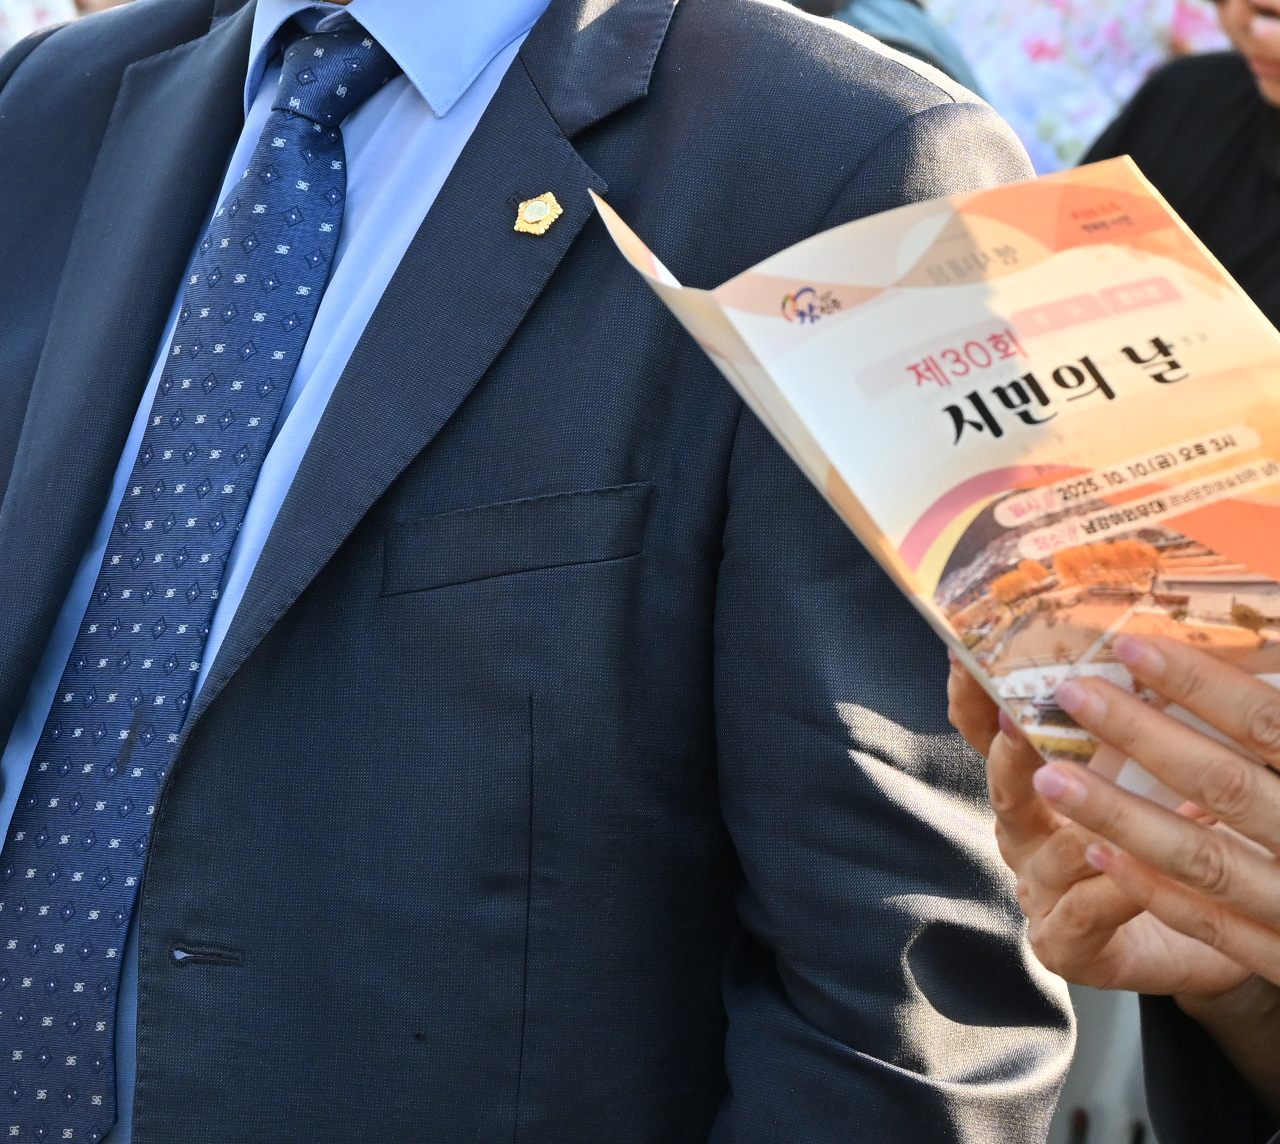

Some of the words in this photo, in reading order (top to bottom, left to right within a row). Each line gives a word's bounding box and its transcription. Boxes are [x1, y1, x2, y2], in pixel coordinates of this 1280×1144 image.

[906, 328, 1029, 387] 제30회
[942, 355, 1116, 445] 시민의
[1121, 336, 1190, 384] 날
[1057, 478, 1104, 501] 2025.
[1179, 442, 1209, 461] 오후
[1209, 434, 1238, 453] 3시
